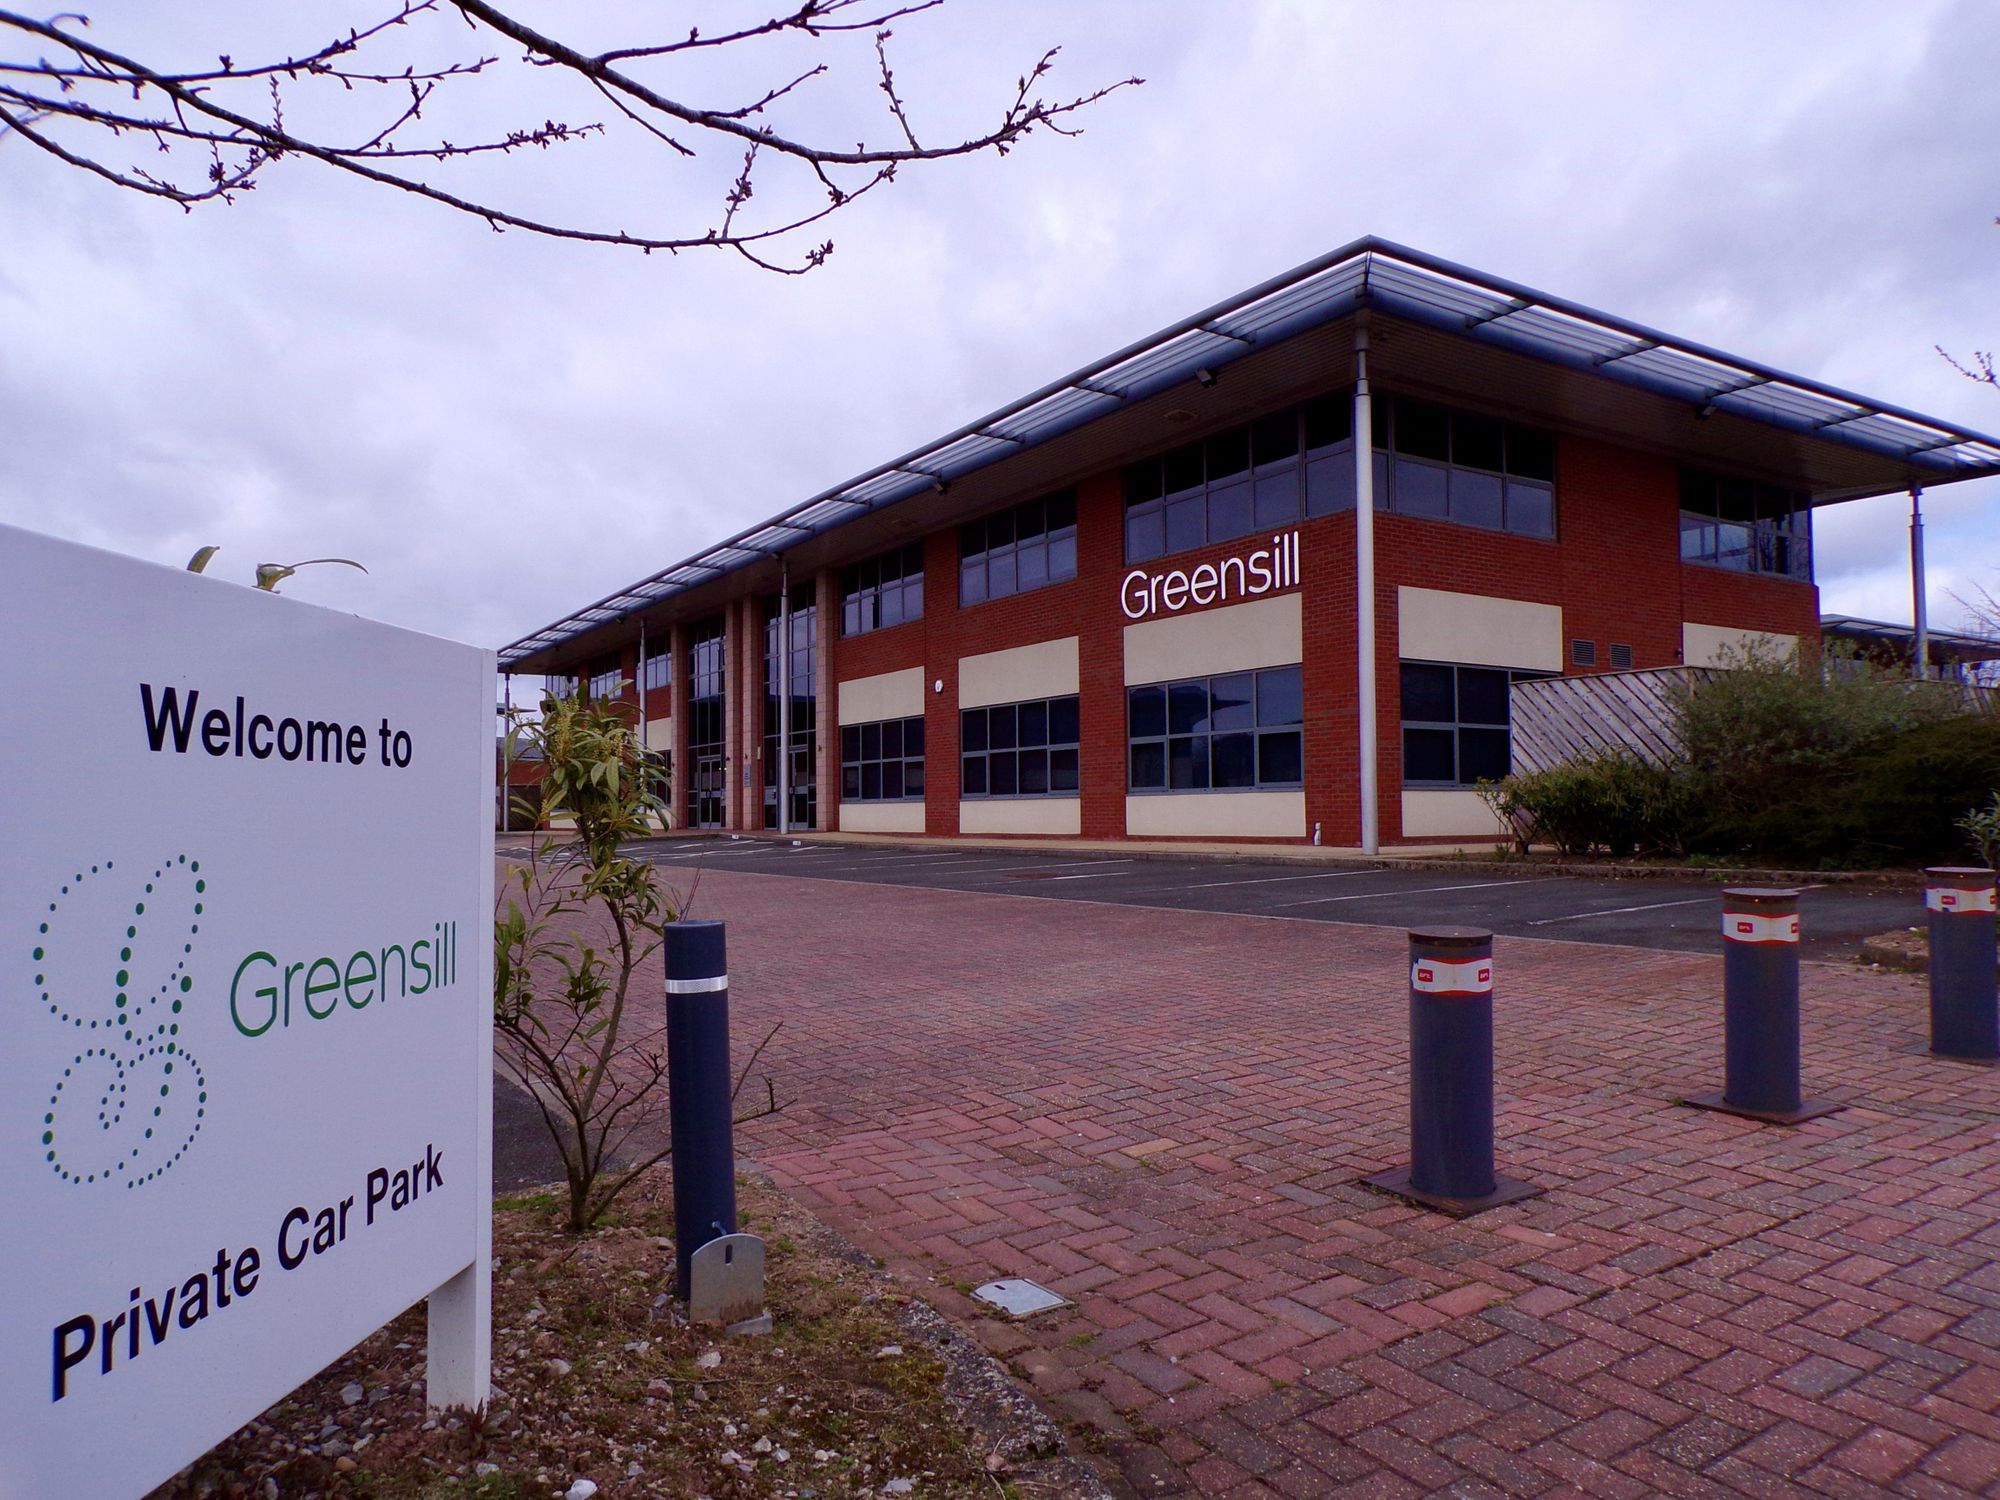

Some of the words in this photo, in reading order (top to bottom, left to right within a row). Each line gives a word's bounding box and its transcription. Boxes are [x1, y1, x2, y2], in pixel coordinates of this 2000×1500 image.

[1121, 531, 1300, 618] Greensill
[140, 684, 366, 765] Welcome
[379, 718, 412, 768] to
[229, 920, 456, 1039] Greensill
[53, 1247, 260, 1402] Private
[278, 1195, 353, 1271] Car
[367, 1144, 443, 1226] Park
